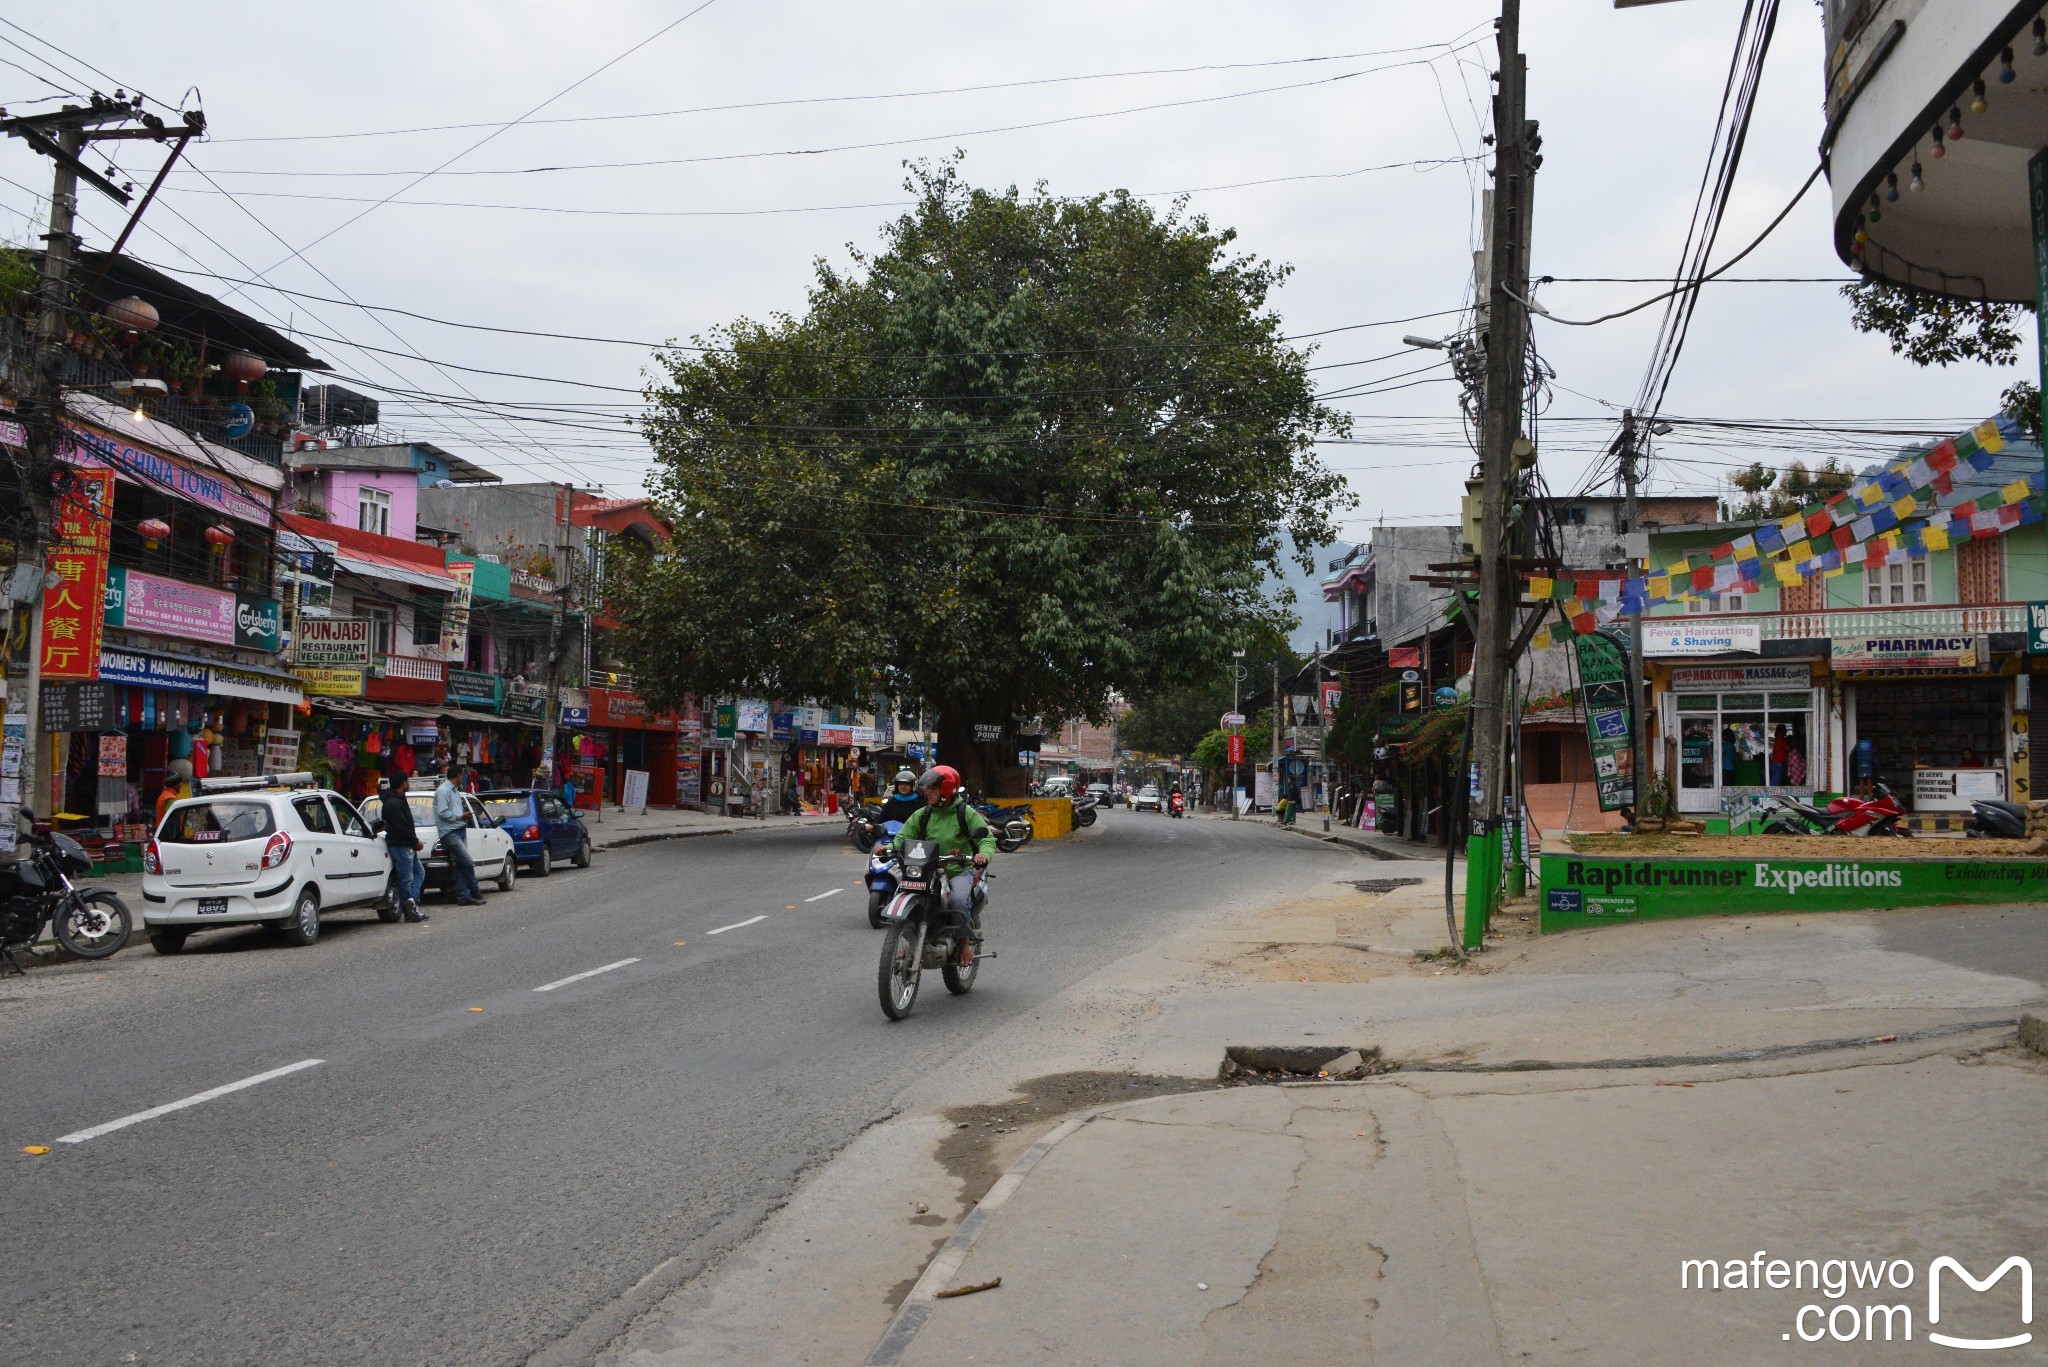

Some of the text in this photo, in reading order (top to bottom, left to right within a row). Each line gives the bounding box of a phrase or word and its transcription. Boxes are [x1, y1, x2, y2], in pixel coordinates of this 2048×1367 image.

[122, 448, 173, 486] CHINA
[180, 467, 223, 502] TOWN
[63, 522, 81, 533] THE
[41, 559, 87, 668] 唐人餐厅
[237, 603, 277, 636] Carlsberg
[302, 622, 366, 641] PUNJABI
[1650, 626, 1753, 637] Fewa Haircutting
[302, 642, 366, 652] RESTAURANT
[1671, 637, 1732, 647] & Shaving
[1866, 637, 1974, 651] PHARMACY
[301, 652, 359, 661] VEGETARIAN
[100, 652, 207, 681] WOMEN'S HANDICRAFT
[296, 670, 332, 681] PUNJABI
[1582, 670, 1623, 682] DUCKY
[1674, 670, 1693, 681] FEWA
[1693, 670, 1712, 681] HAIR
[1713, 669, 1745, 681] CUTTING
[1746, 668, 1786, 679] MASSAGE
[261, 677, 282, 693] Paper
[720, 714, 731, 724] FLY
[886, 717, 894, 744] TATTOO
[974, 724, 1002, 732] CENTRE
[199, 832, 220, 840] TAXI
[1567, 862, 1747, 894] Rapidrunner
[1755, 863, 1902, 894] Expeditions
[1946, 864, 2025, 886] Exhilarating
